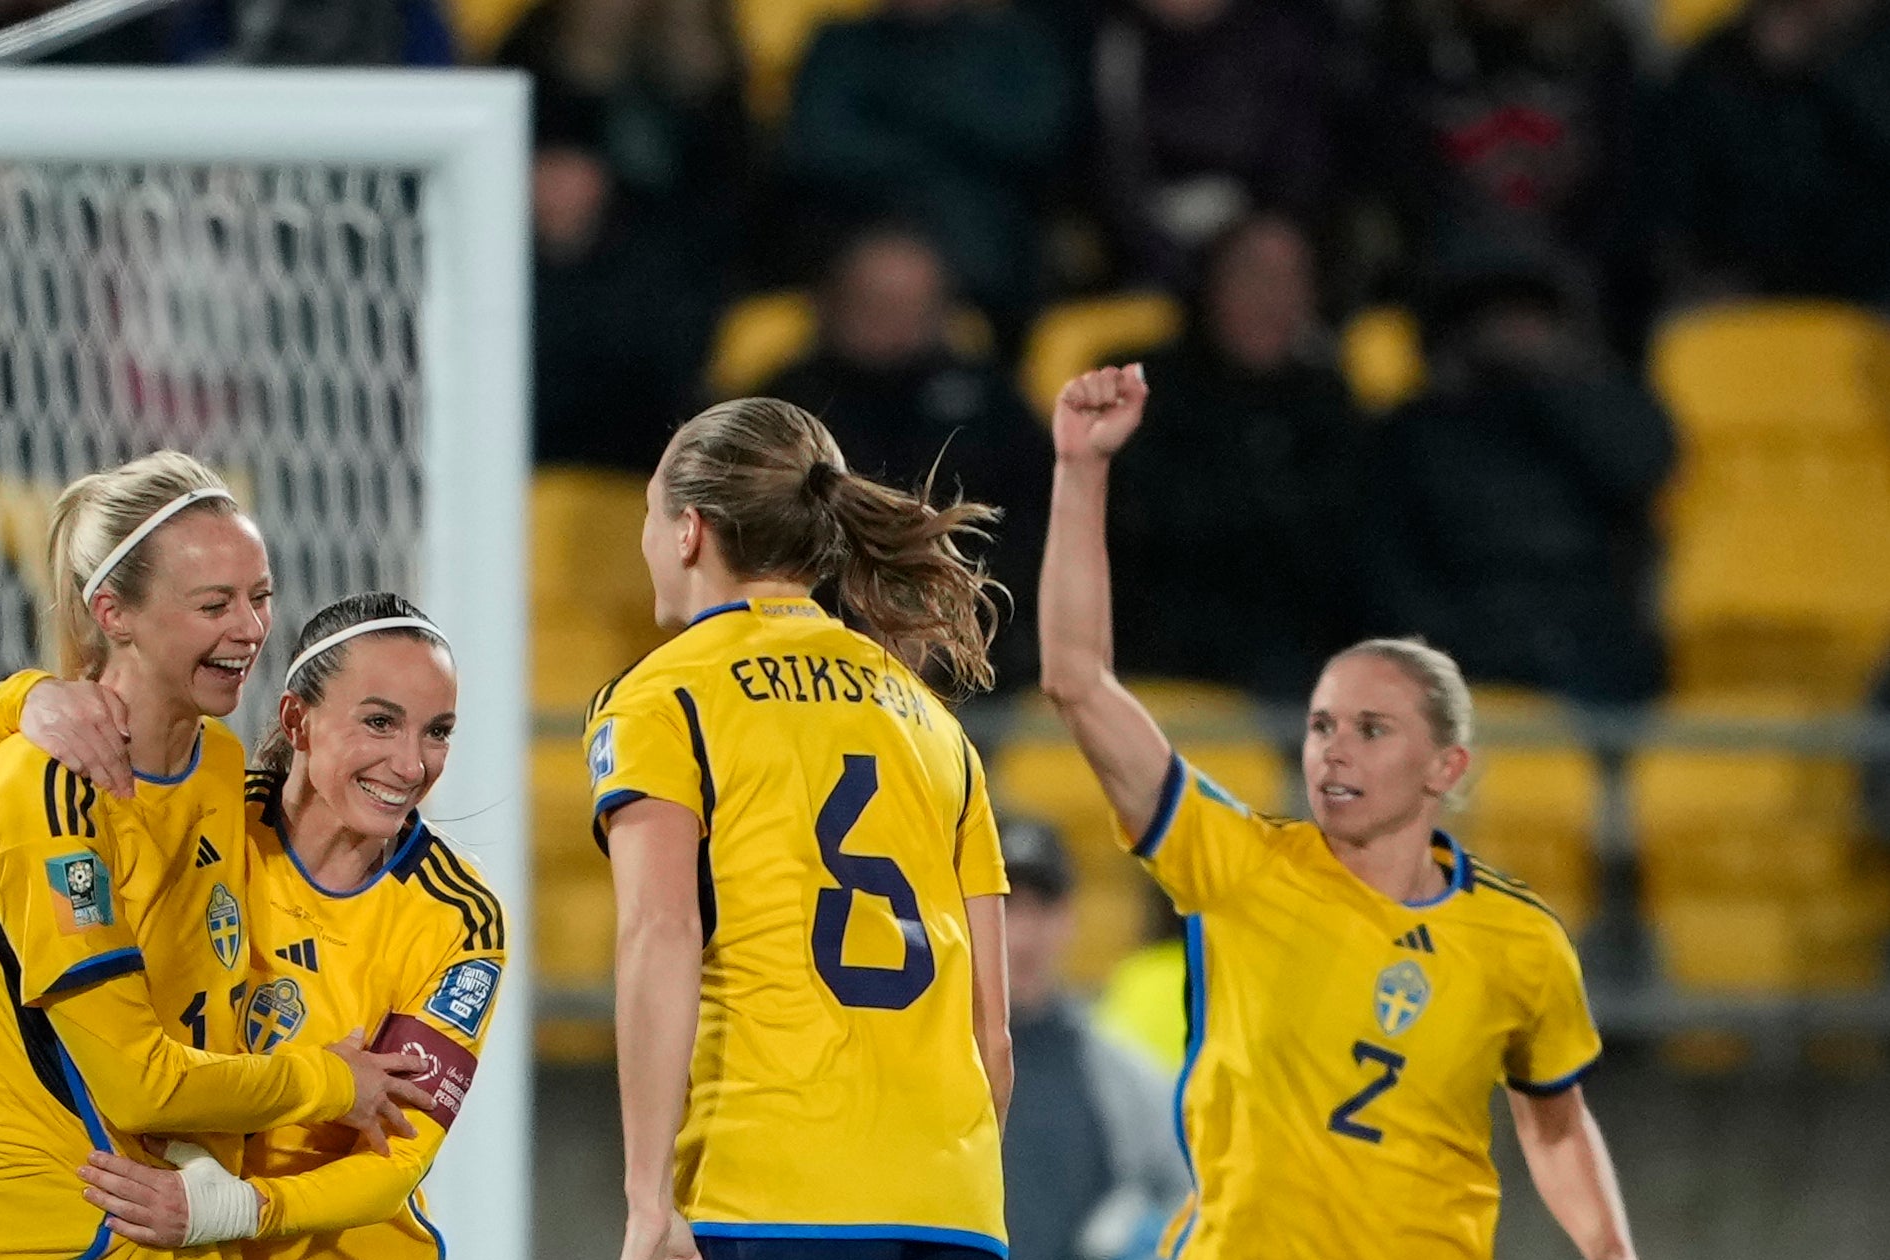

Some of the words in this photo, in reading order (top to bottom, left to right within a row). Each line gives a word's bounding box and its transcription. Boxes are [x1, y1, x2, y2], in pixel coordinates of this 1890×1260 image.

[731, 654, 933, 731] ERIKSSON
[811, 754, 935, 1010] 6
[455, 974, 490, 999] UNITES
[1327, 1038, 1407, 1144] 2
